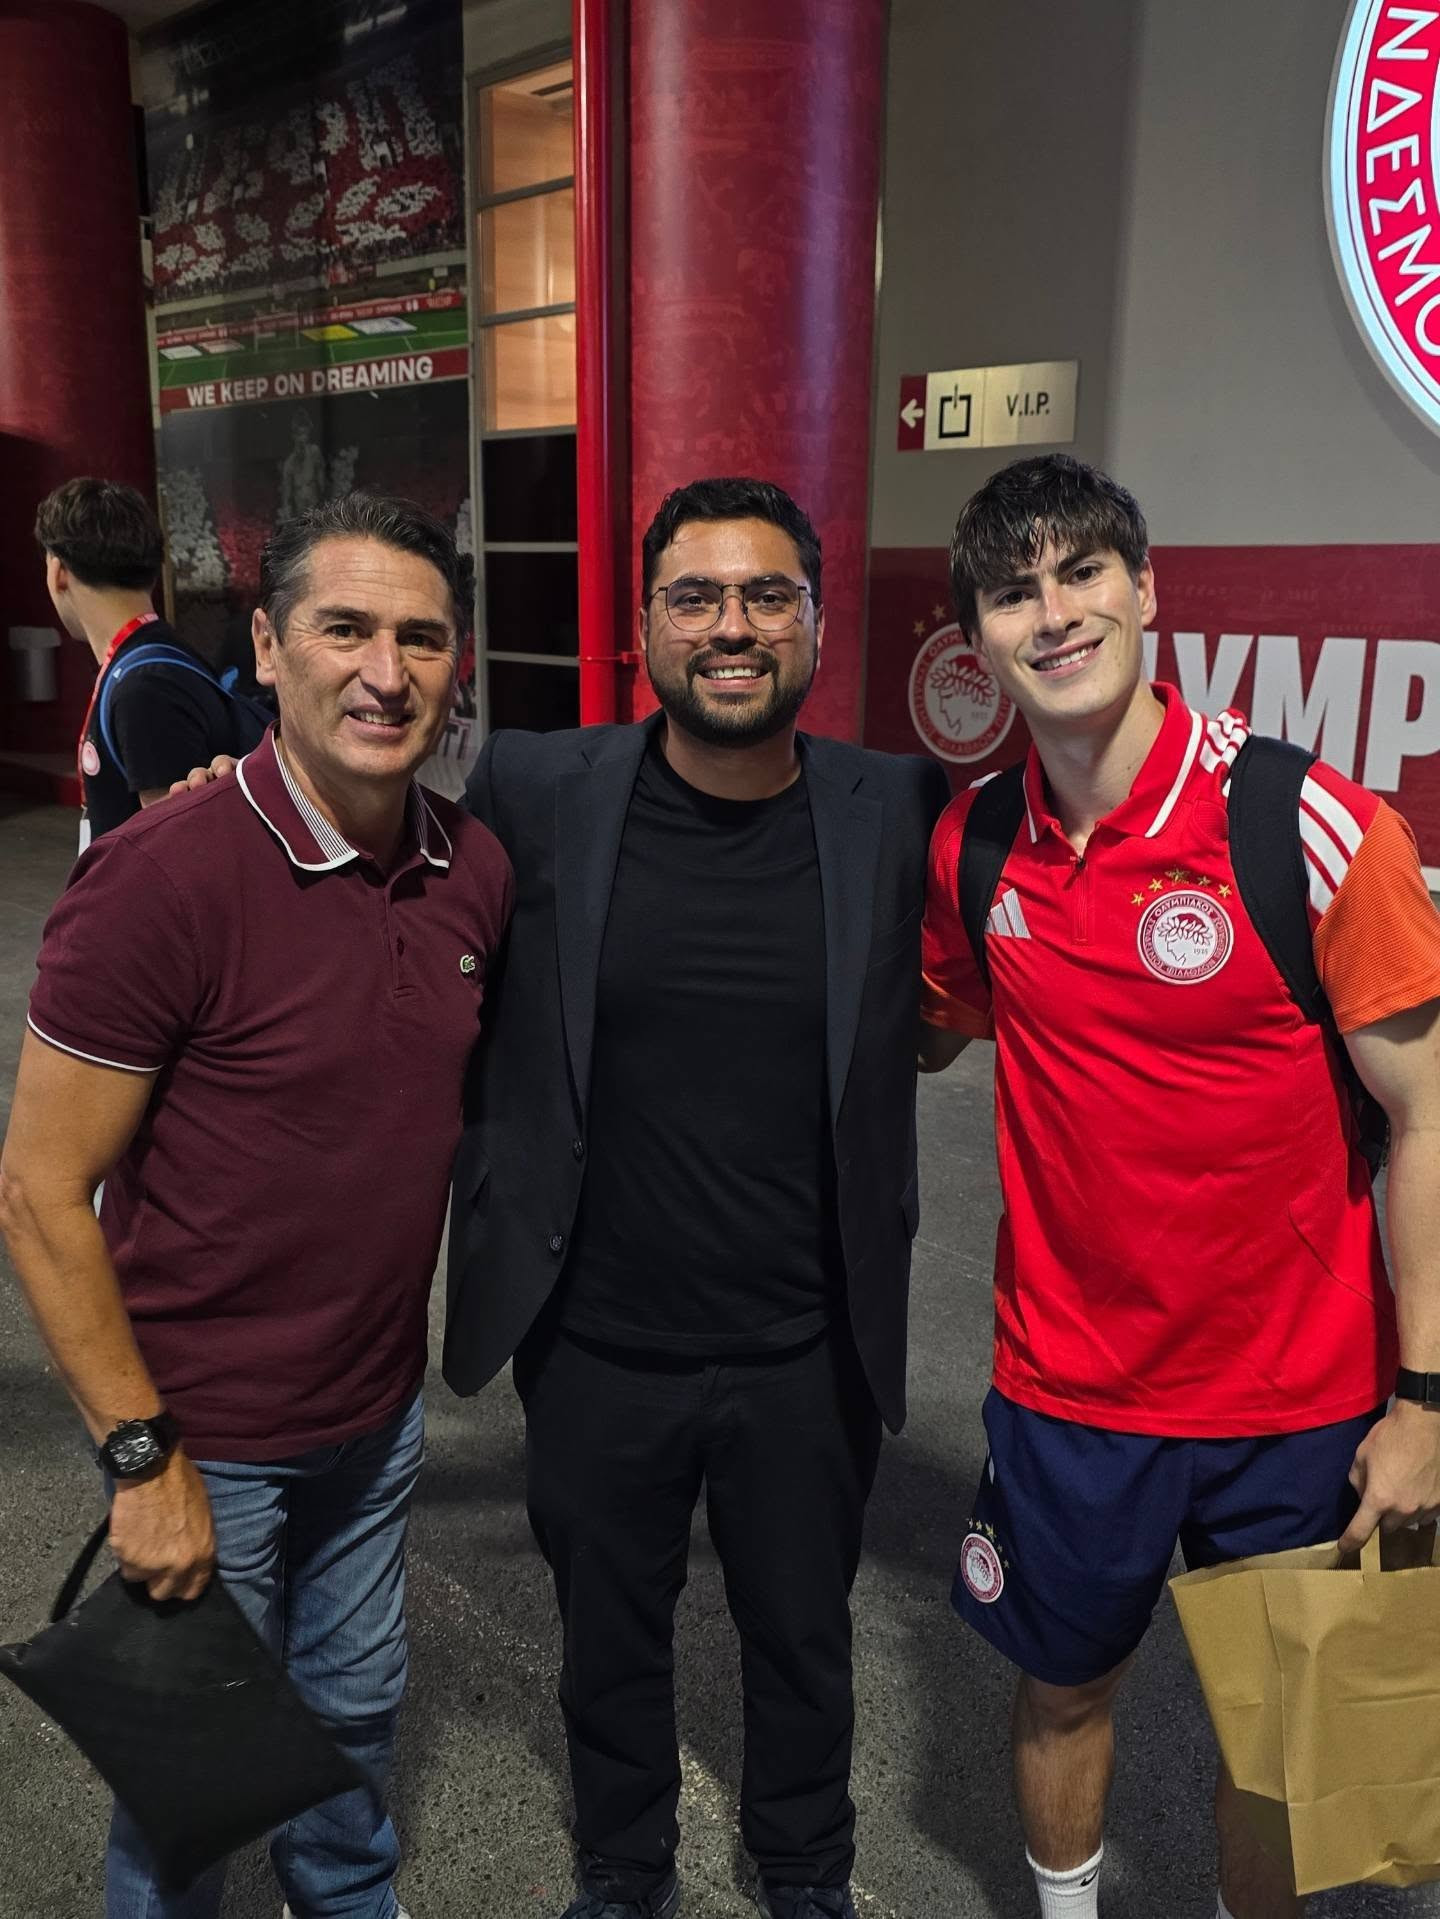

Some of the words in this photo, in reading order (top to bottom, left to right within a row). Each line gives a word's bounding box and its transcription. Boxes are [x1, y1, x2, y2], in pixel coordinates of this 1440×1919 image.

[186, 385, 215, 407] WE
[220, 377, 269, 403] KEEP
[274, 373, 302, 396] ON
[311, 356, 433, 393] DREAMING
[1007, 391, 1050, 417] V.I.P.
[1143, 631, 1440, 792] YMP
